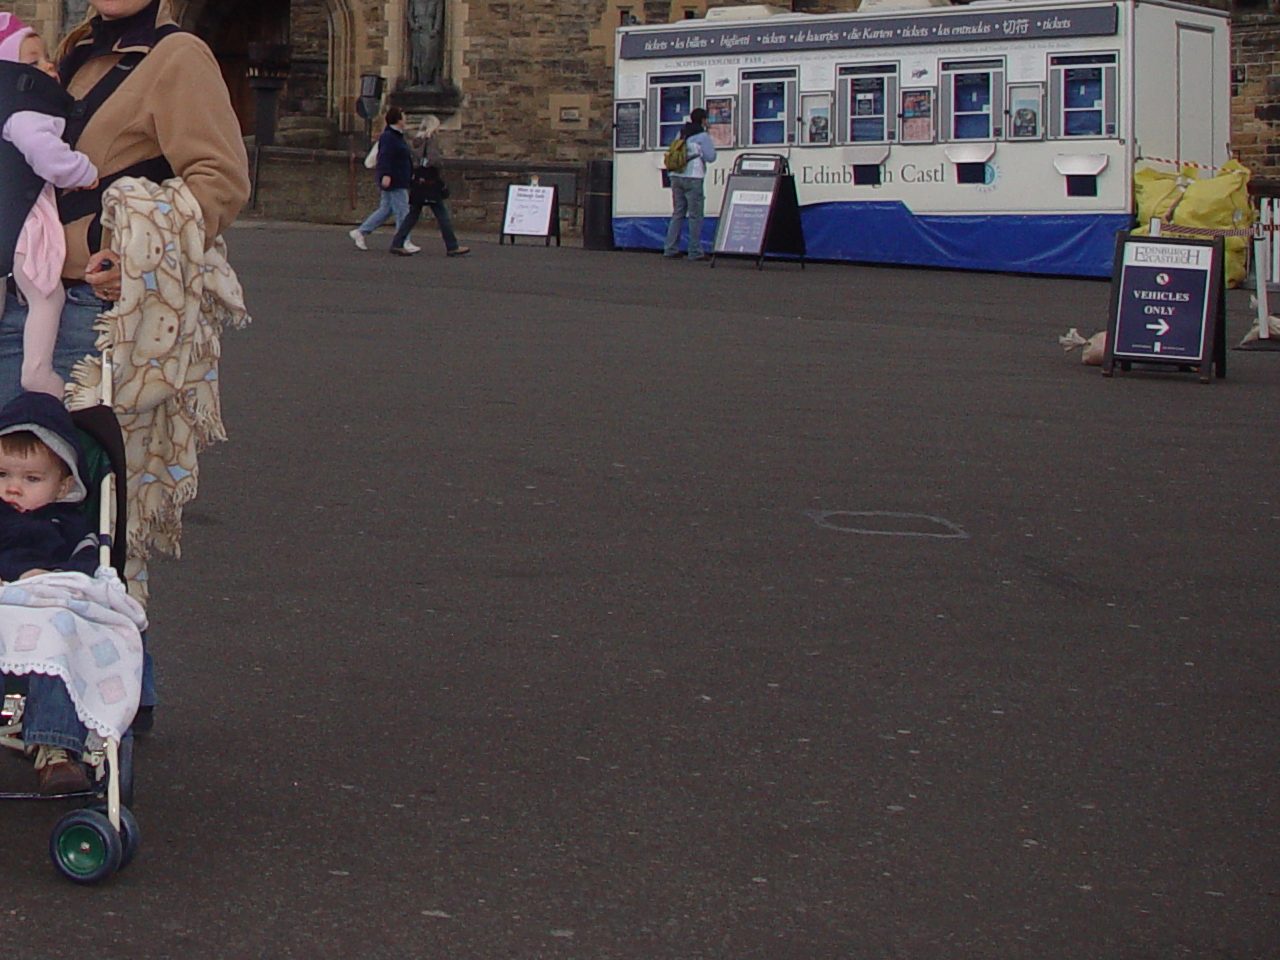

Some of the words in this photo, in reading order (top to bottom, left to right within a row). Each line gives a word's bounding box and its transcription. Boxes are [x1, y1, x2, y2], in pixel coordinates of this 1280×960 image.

[1002, 18, 1030, 35] 切符
[1041, 15, 1072, 30] tickets
[644, 38, 668, 51] tickets
[761, 31, 787, 45] tickets
[847, 27, 862, 40] die
[862, 27, 894, 40] Karten
[901, 24, 929, 38] tickets
[801, 164, 893, 189] Edinbh
[1134, 246, 1200, 265] EDINBURGH
[1148, 254, 1182, 264] CASTLE
[1133, 290, 1190, 302] VEHICLES
[1144, 305, 1175, 316] ONLY
